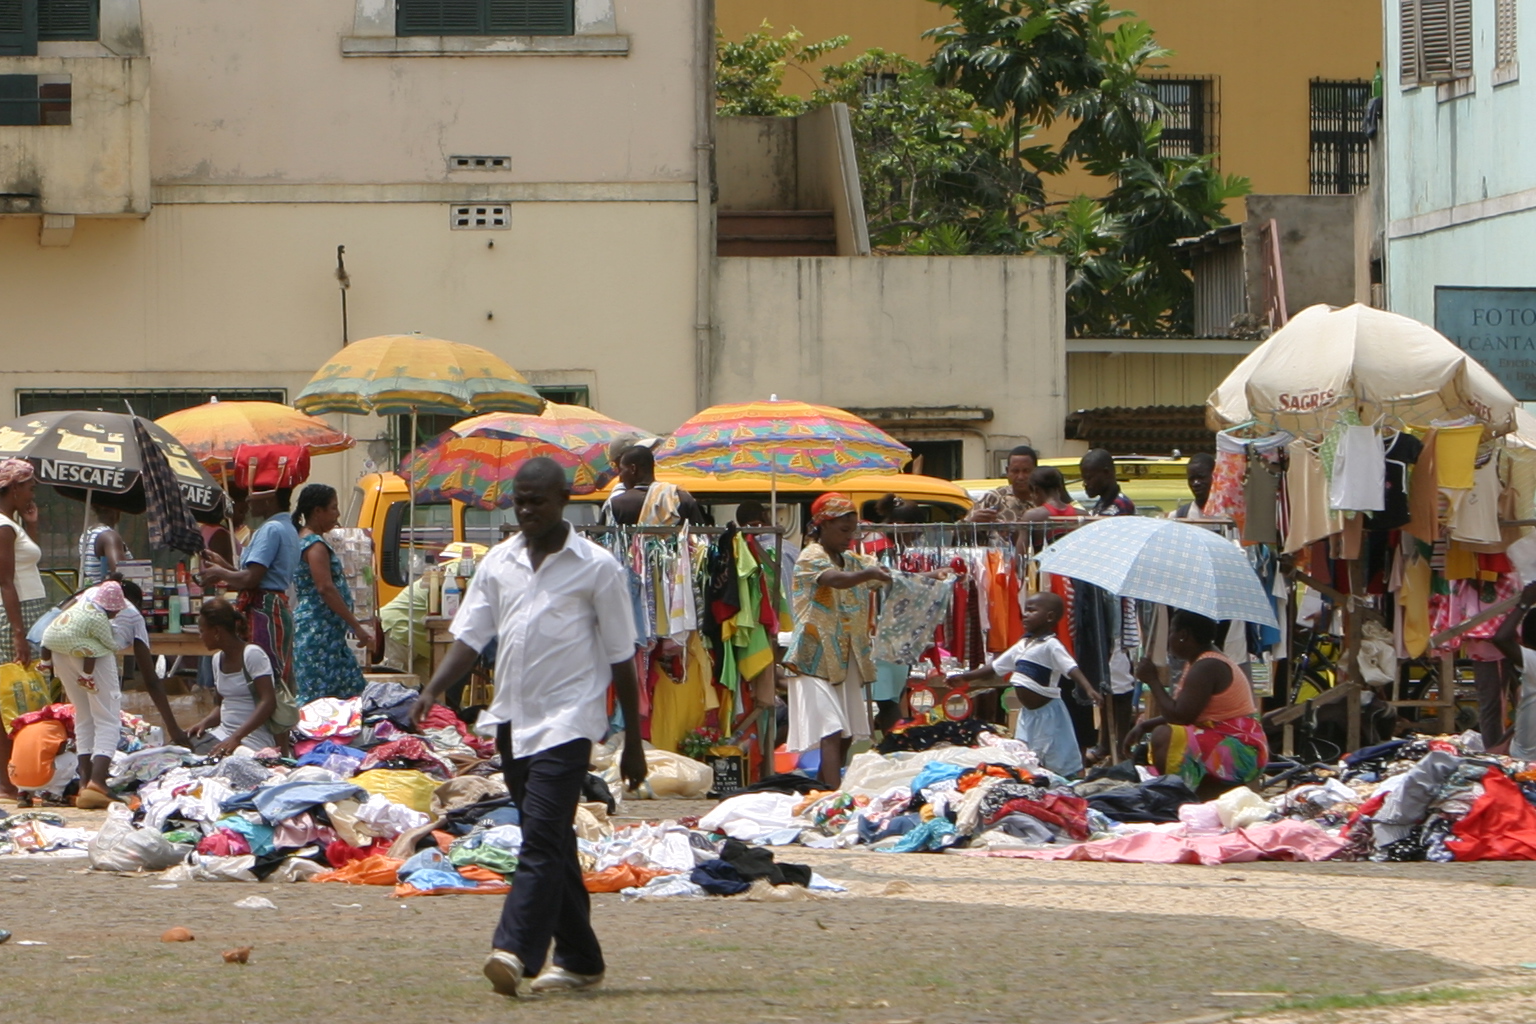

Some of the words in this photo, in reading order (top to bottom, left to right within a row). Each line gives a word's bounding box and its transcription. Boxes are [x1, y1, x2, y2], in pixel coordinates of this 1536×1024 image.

[1472, 308, 1536, 327] FOTO
[1456, 333, 1536, 352] LCÂNTA
[40, 458, 125, 489] NESCAFÉ
[177, 479, 213, 507] CAFÉ
